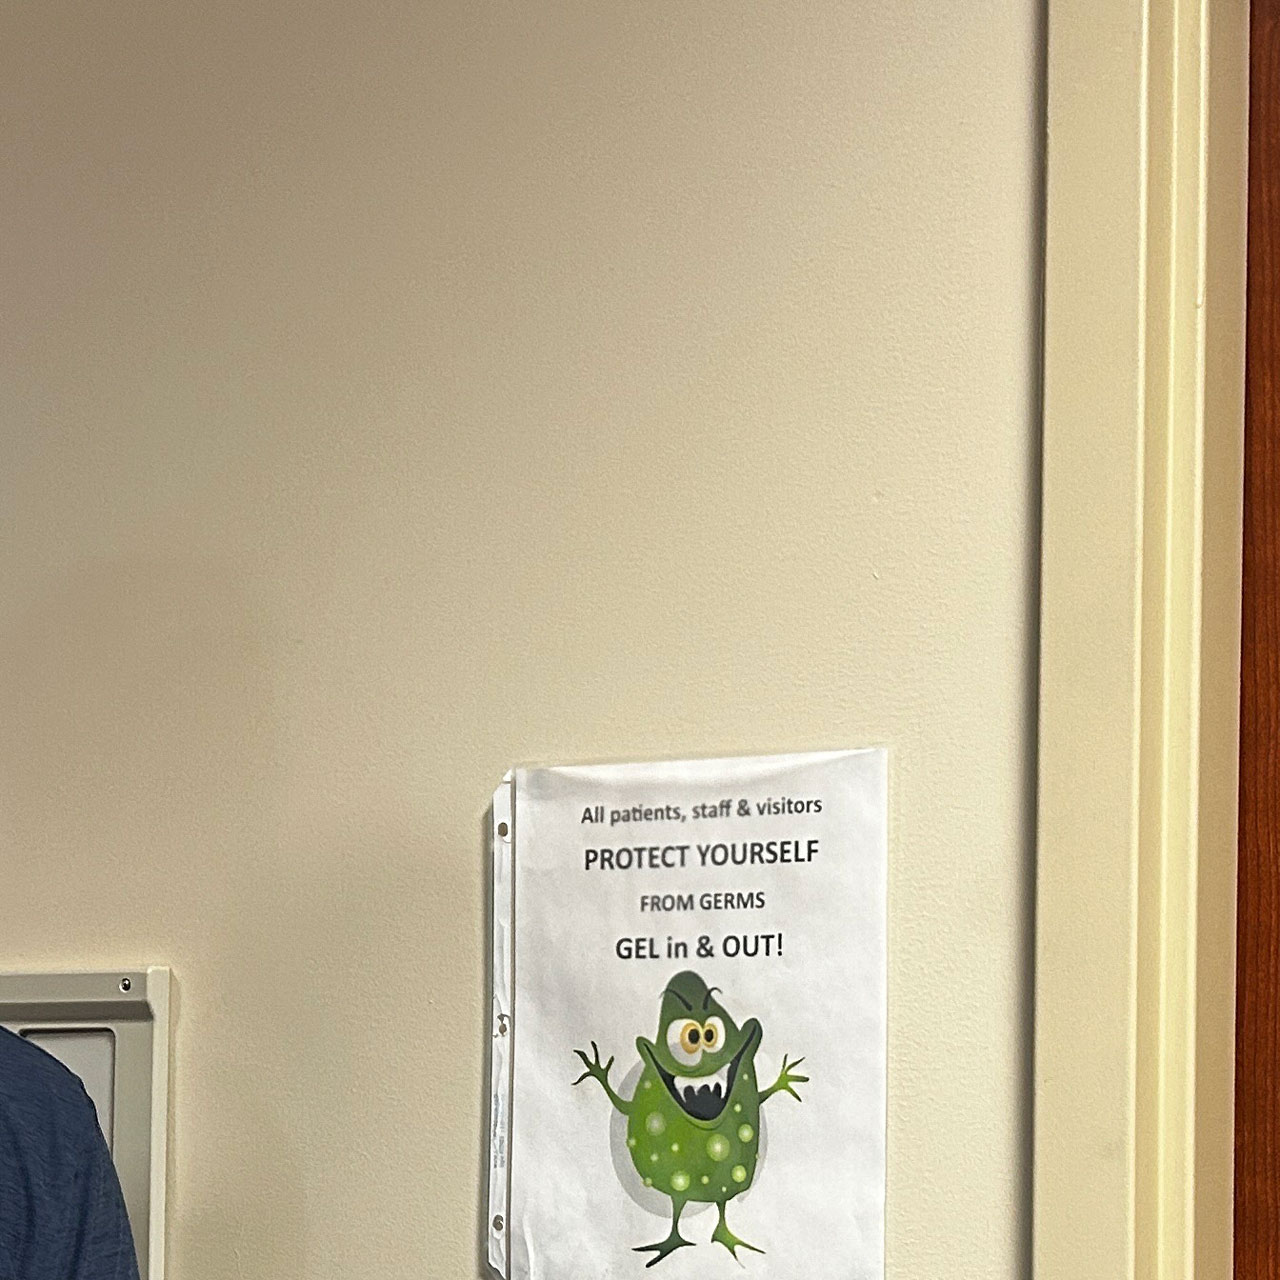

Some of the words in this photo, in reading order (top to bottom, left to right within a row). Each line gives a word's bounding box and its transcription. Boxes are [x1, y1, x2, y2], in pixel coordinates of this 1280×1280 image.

[581, 807, 605, 824] All
[610, 804, 686, 826] patients,
[692, 799, 732, 819] staff
[737, 799, 751, 817] &
[756, 797, 823, 816] visitors
[585, 845, 690, 871] PROTECT
[697, 839, 819, 866] YOURSELF
[640, 894, 694, 912] FROM
[699, 891, 766, 911] GERMS
[615, 937, 660, 960] GEL
[667, 936, 688, 959] in
[696, 935, 715, 959] &
[722, 932, 784, 958] OUT!
